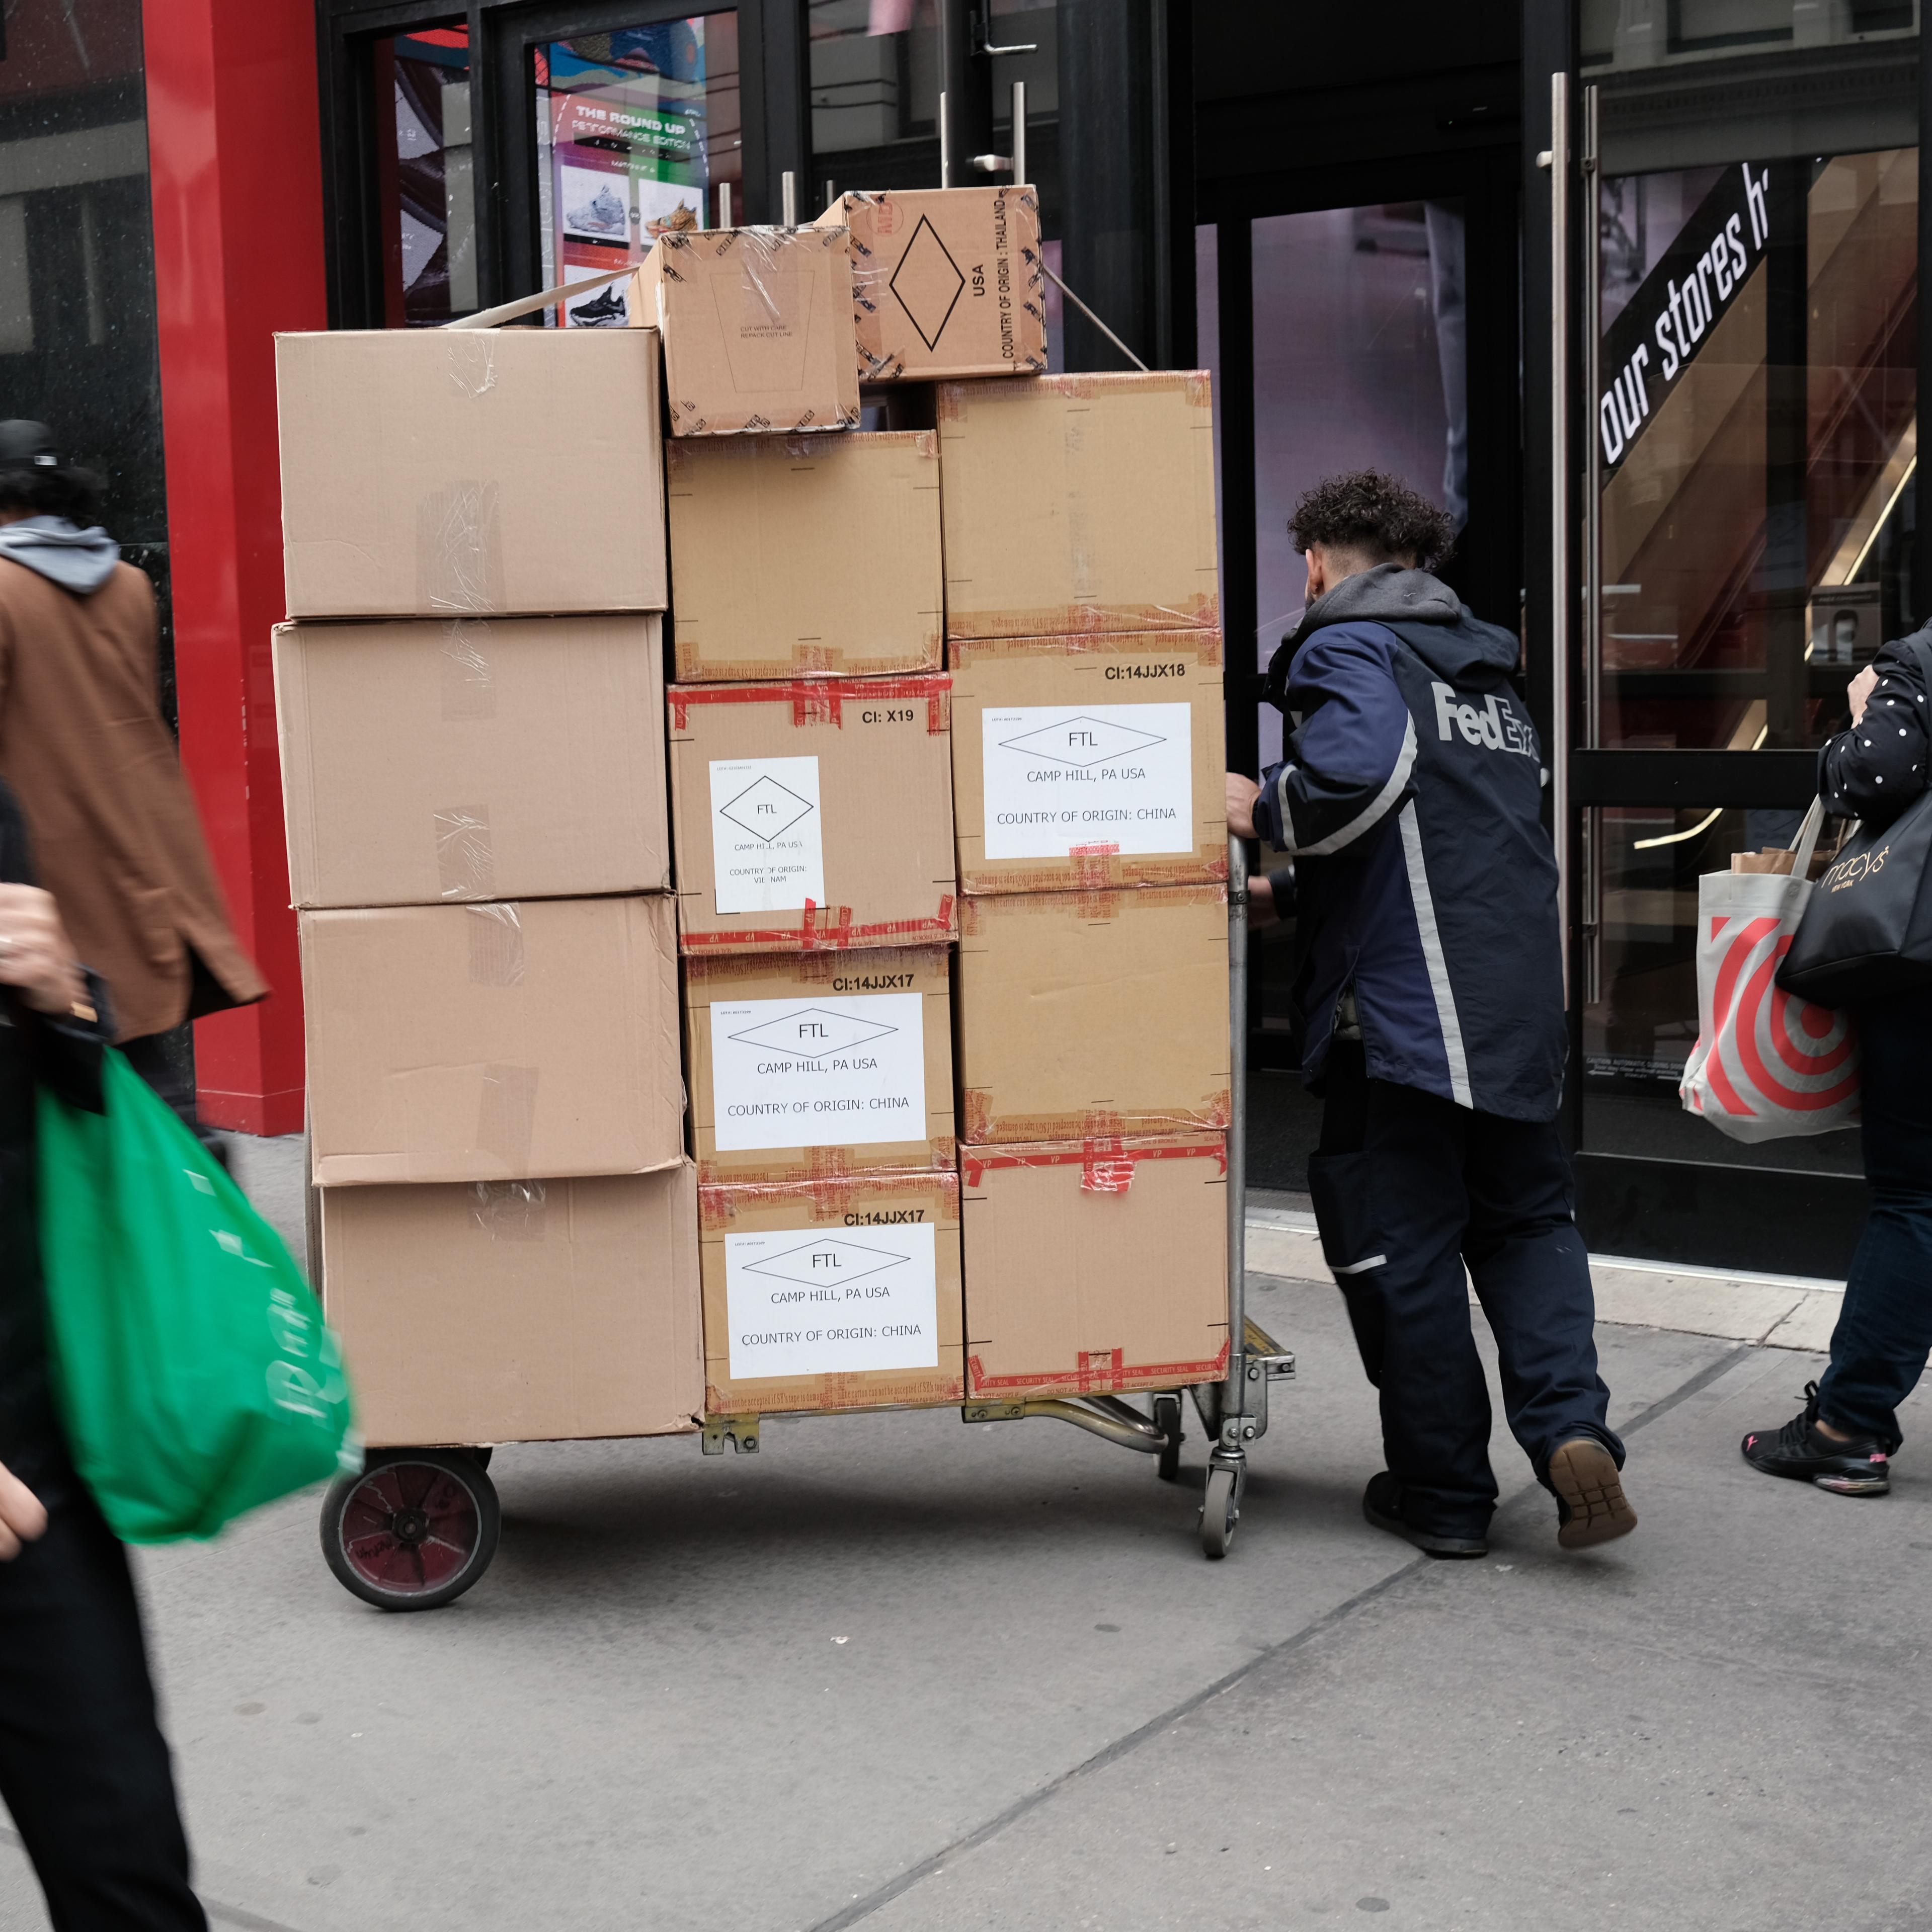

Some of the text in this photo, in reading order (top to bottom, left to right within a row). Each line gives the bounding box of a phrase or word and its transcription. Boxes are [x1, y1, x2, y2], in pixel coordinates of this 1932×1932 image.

[576, 106, 686, 135] THE ROUND UP
[994, 200, 1007, 250] THAILAND
[972, 264, 985, 297] USA
[997, 257, 1010, 293] ORIGIN
[999, 295, 1011, 308] OF
[1000, 311, 1014, 358] COUNTRY
[1601, 343, 1649, 464] our
[1654, 213, 1747, 381] stores
[1104, 664, 1186, 680] CI:14JJX18
[862, 709, 914, 724] CI: X19
[1431, 681, 1541, 763] FedEx
[1068, 732, 1098, 747] FTL
[1027, 768, 1146, 783] CAMP HILL, PA USA
[757, 803, 777, 814] FTL
[997, 808, 1177, 825] COUNTRY OF ORIGIN: CHINA
[730, 867, 763, 876] COUNTRY
[778, 865, 807, 873] ORIGIN:
[1033, 872, 1055, 884] accepted
[1055, 874, 1061, 882] be
[999, 876, 1003, 887] is
[1004, 872, 1014, 886] tape
[1027, 875, 1031, 886] if
[887, 924, 896, 933] VP
[709, 934, 718, 942] VP
[745, 932, 754, 941] VP
[832, 974, 914, 991] CI:14JJX17
[799, 1023, 829, 1038] FTL
[757, 1058, 877, 1074] CAMP HILL, PA USA
[728, 1097, 909, 1116] COUNTRY OF ORIGIN: CHINA
[1025, 1120, 1035, 1132] tape
[1047, 1123, 1052, 1133] if
[983, 1160, 992, 1168] VP
[844, 1209, 925, 1226] CI:14JJX17
[813, 1253, 842, 1268] FTL
[771, 1286, 890, 1304] CAMP HILL, PA USA
[742, 1324, 921, 1345] COUNTRY OF ORIGIN: CHINA
[1016, 1377, 1040, 1385] SECURITY
[1042, 1376, 1054, 1384] SEAL
[1151, 1366, 1175, 1375] SECURITY
[1195, 1363, 1216, 1371] SECURI
[855, 1388, 866, 1397] carton
[887, 1386, 894, 1395] be
[895, 1384, 916, 1397] accepted
[918, 1383, 922, 1393] if
[732, 1400, 741, 1408] not
[741, 1399, 747, 1407] be
[748, 1396, 771, 1409] accepted
[771, 1396, 776, 1404] if
[789, 1394, 799, 1405] tape
